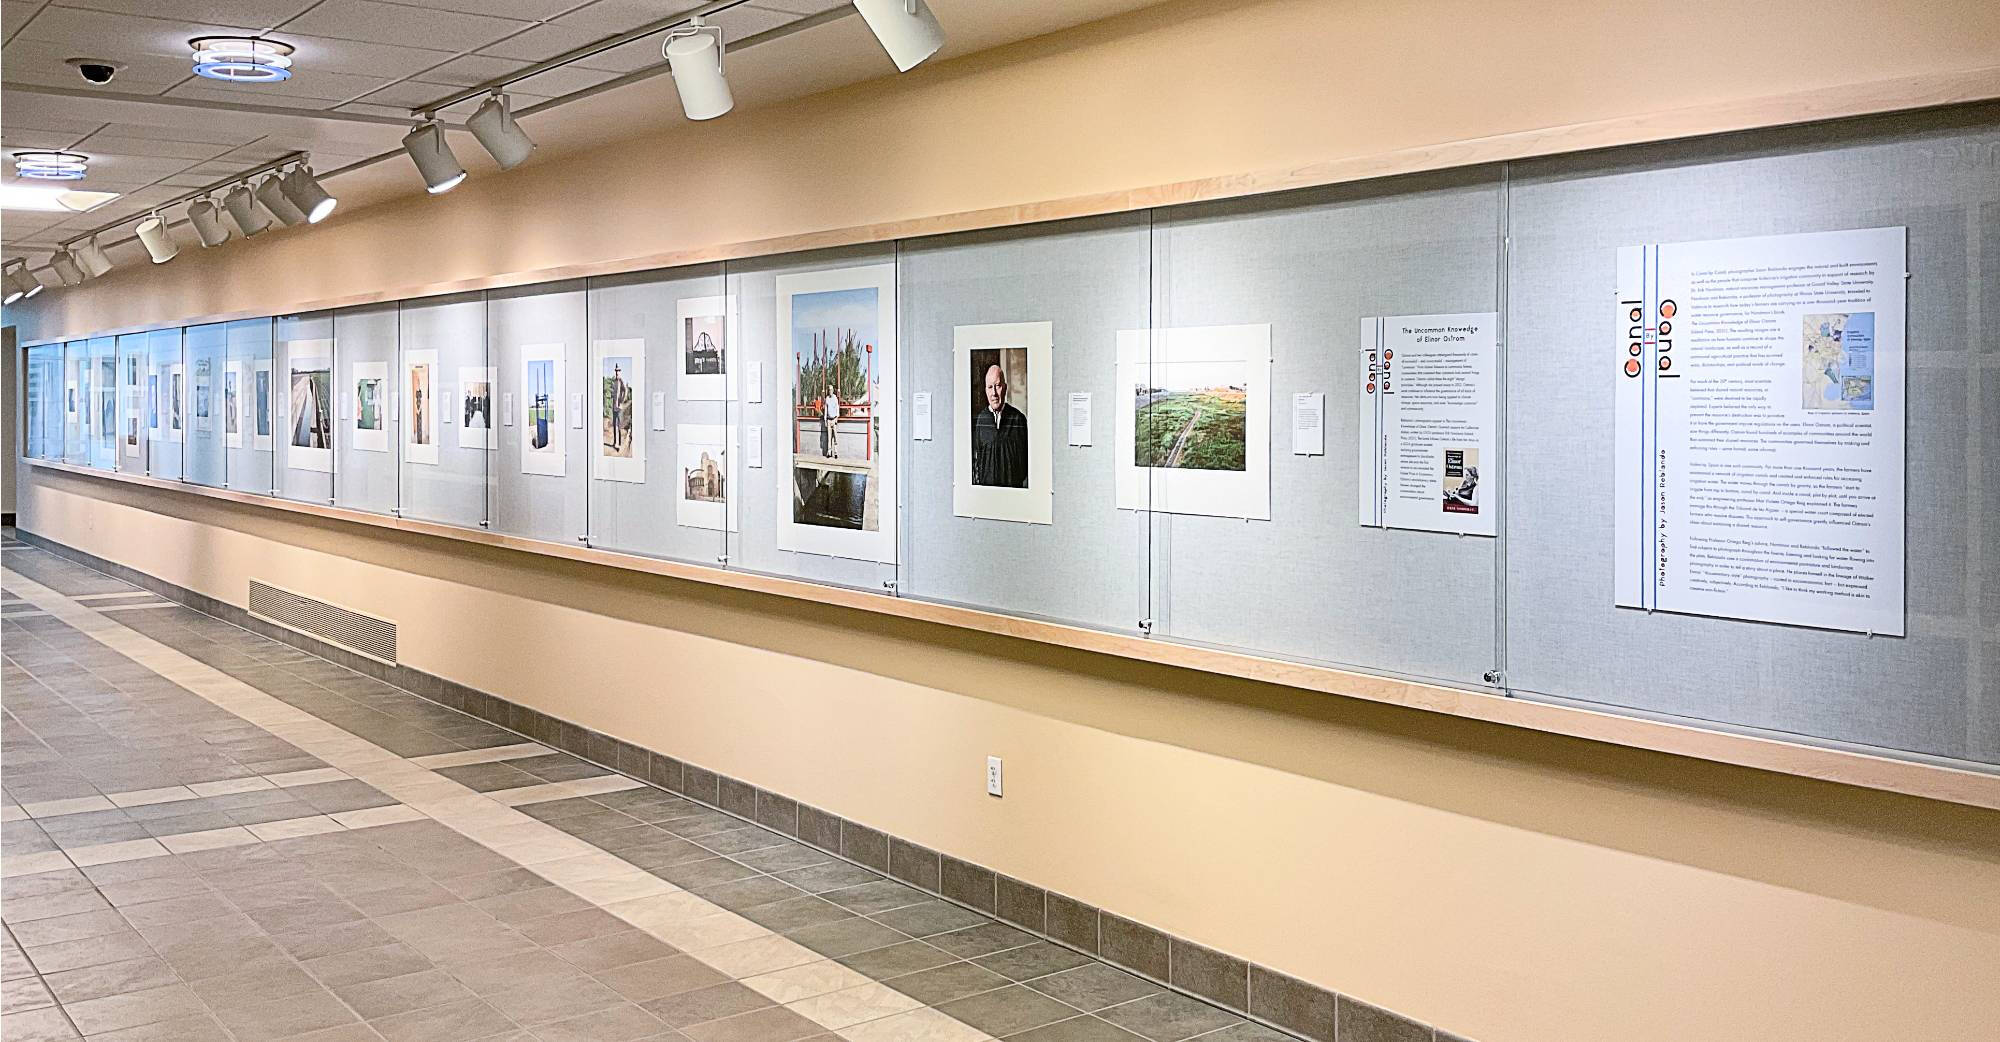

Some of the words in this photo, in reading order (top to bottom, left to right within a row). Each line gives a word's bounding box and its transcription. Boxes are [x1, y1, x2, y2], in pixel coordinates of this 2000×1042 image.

[1621, 301, 1642, 378] Canal
[1659, 299, 1680, 378] Canal
[1365, 349, 1376, 394] Canal
[1384, 349, 1394, 394] Canal
[1659, 518, 1667, 529] by
[1659, 533, 1668, 587] Photography
